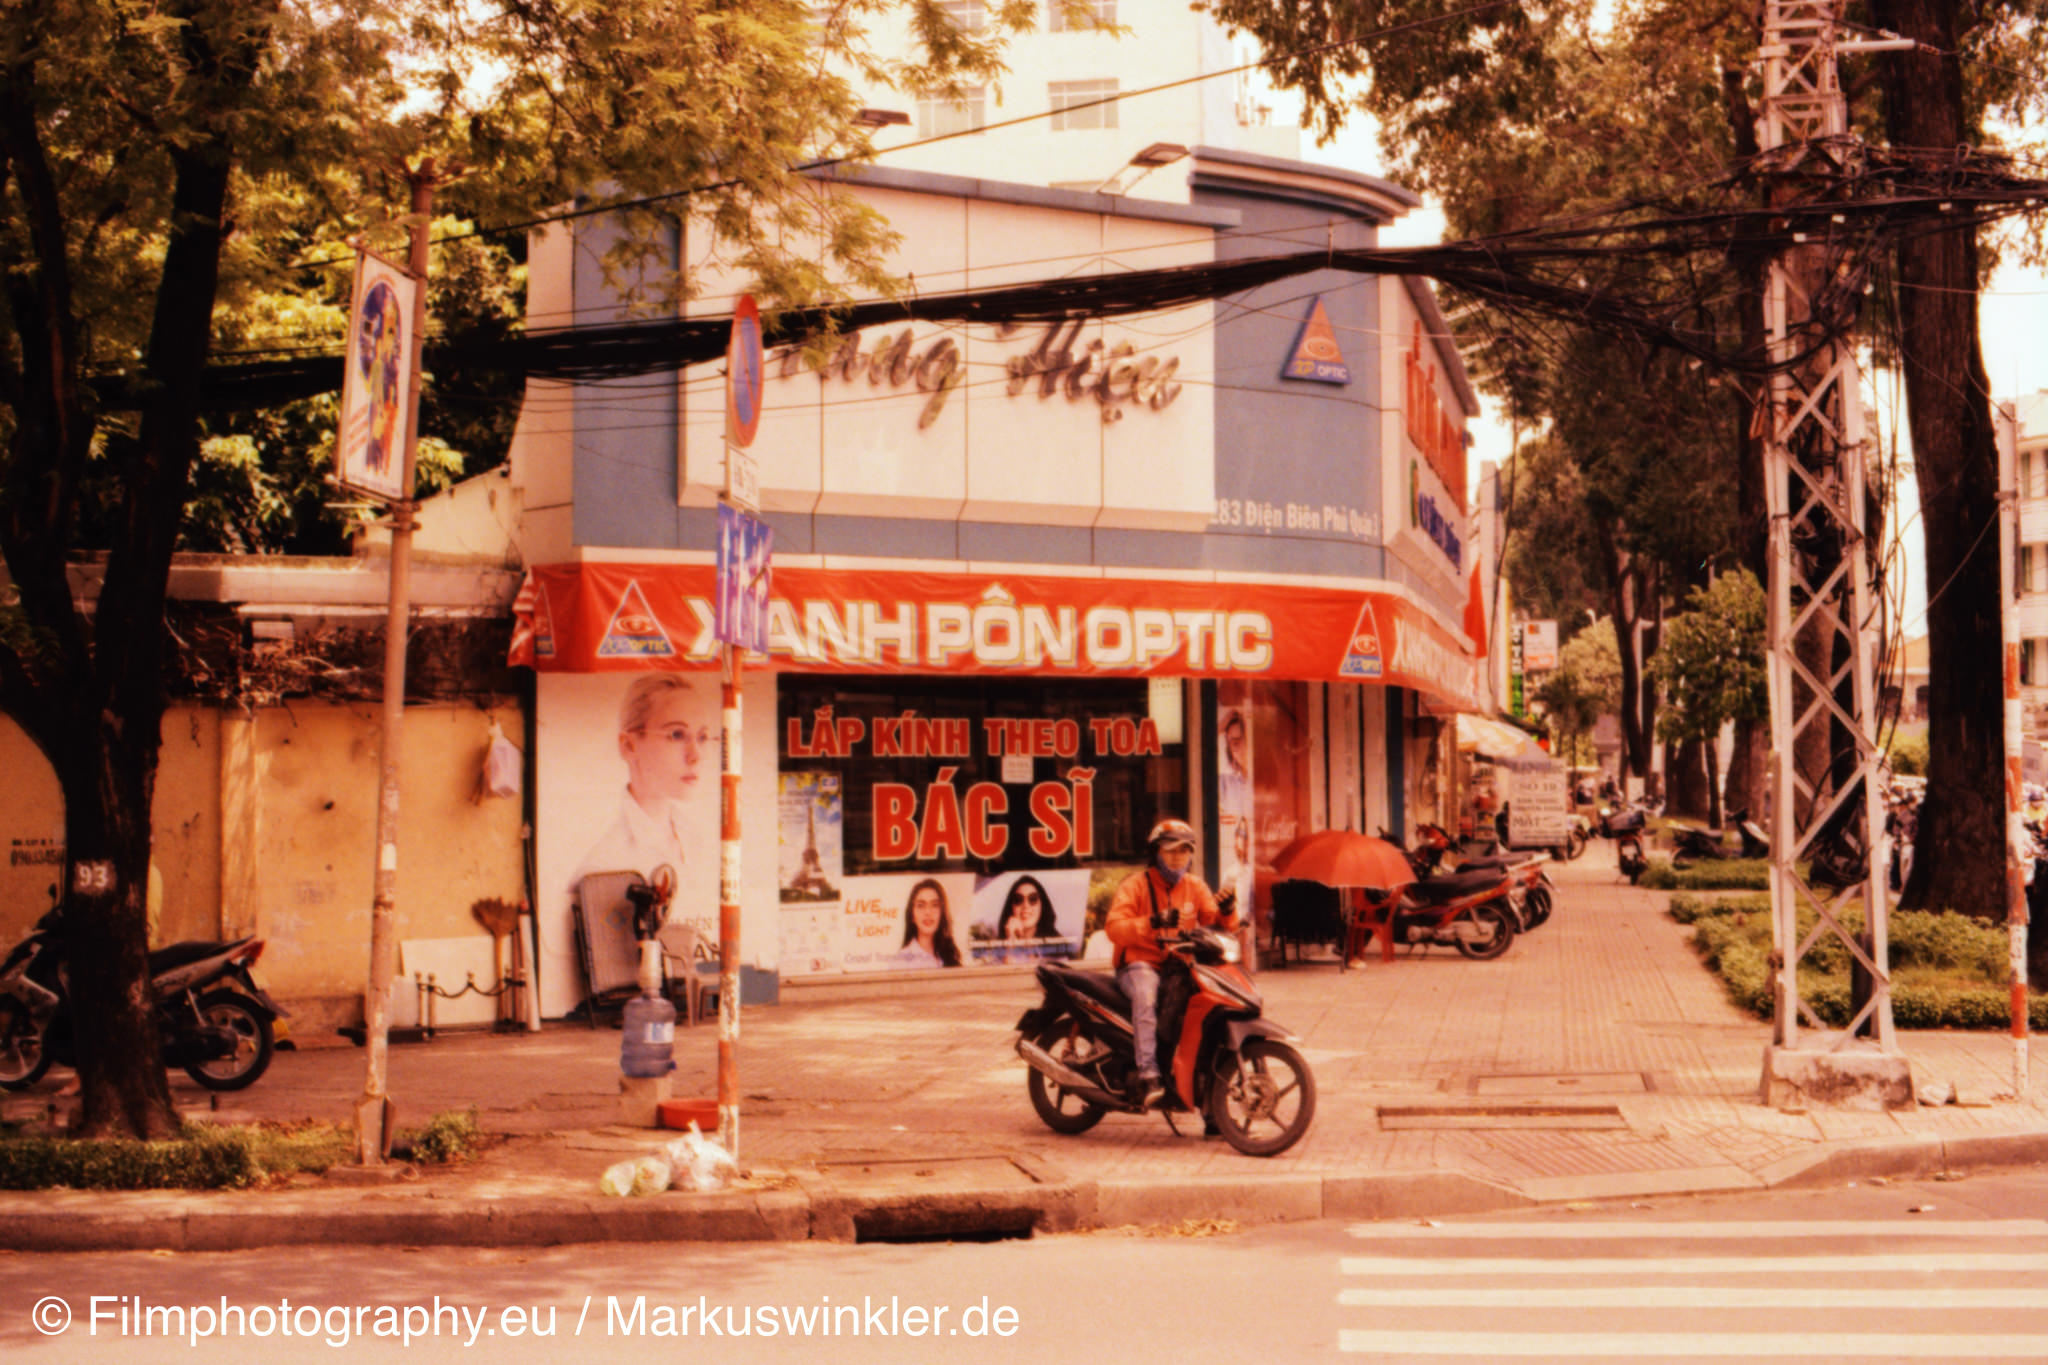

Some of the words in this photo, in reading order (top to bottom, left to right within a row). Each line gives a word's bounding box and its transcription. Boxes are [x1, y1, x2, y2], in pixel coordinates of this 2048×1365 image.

[1246, 501, 1282, 534] Điện
[925, 583, 1075, 668] PÔN
[1085, 605, 1273, 671] OPTIC
[788, 705, 865, 758] LẮP
[872, 710, 971, 758] KÍNH
[983, 718, 1081, 758] THEO
[1089, 718, 1163, 756] TOA
[872, 766, 1009, 861] BÁC
[1028, 767, 1096, 859] SĨ
[78, 865, 109, 887] 93
[844, 898, 882, 915] LIVE
